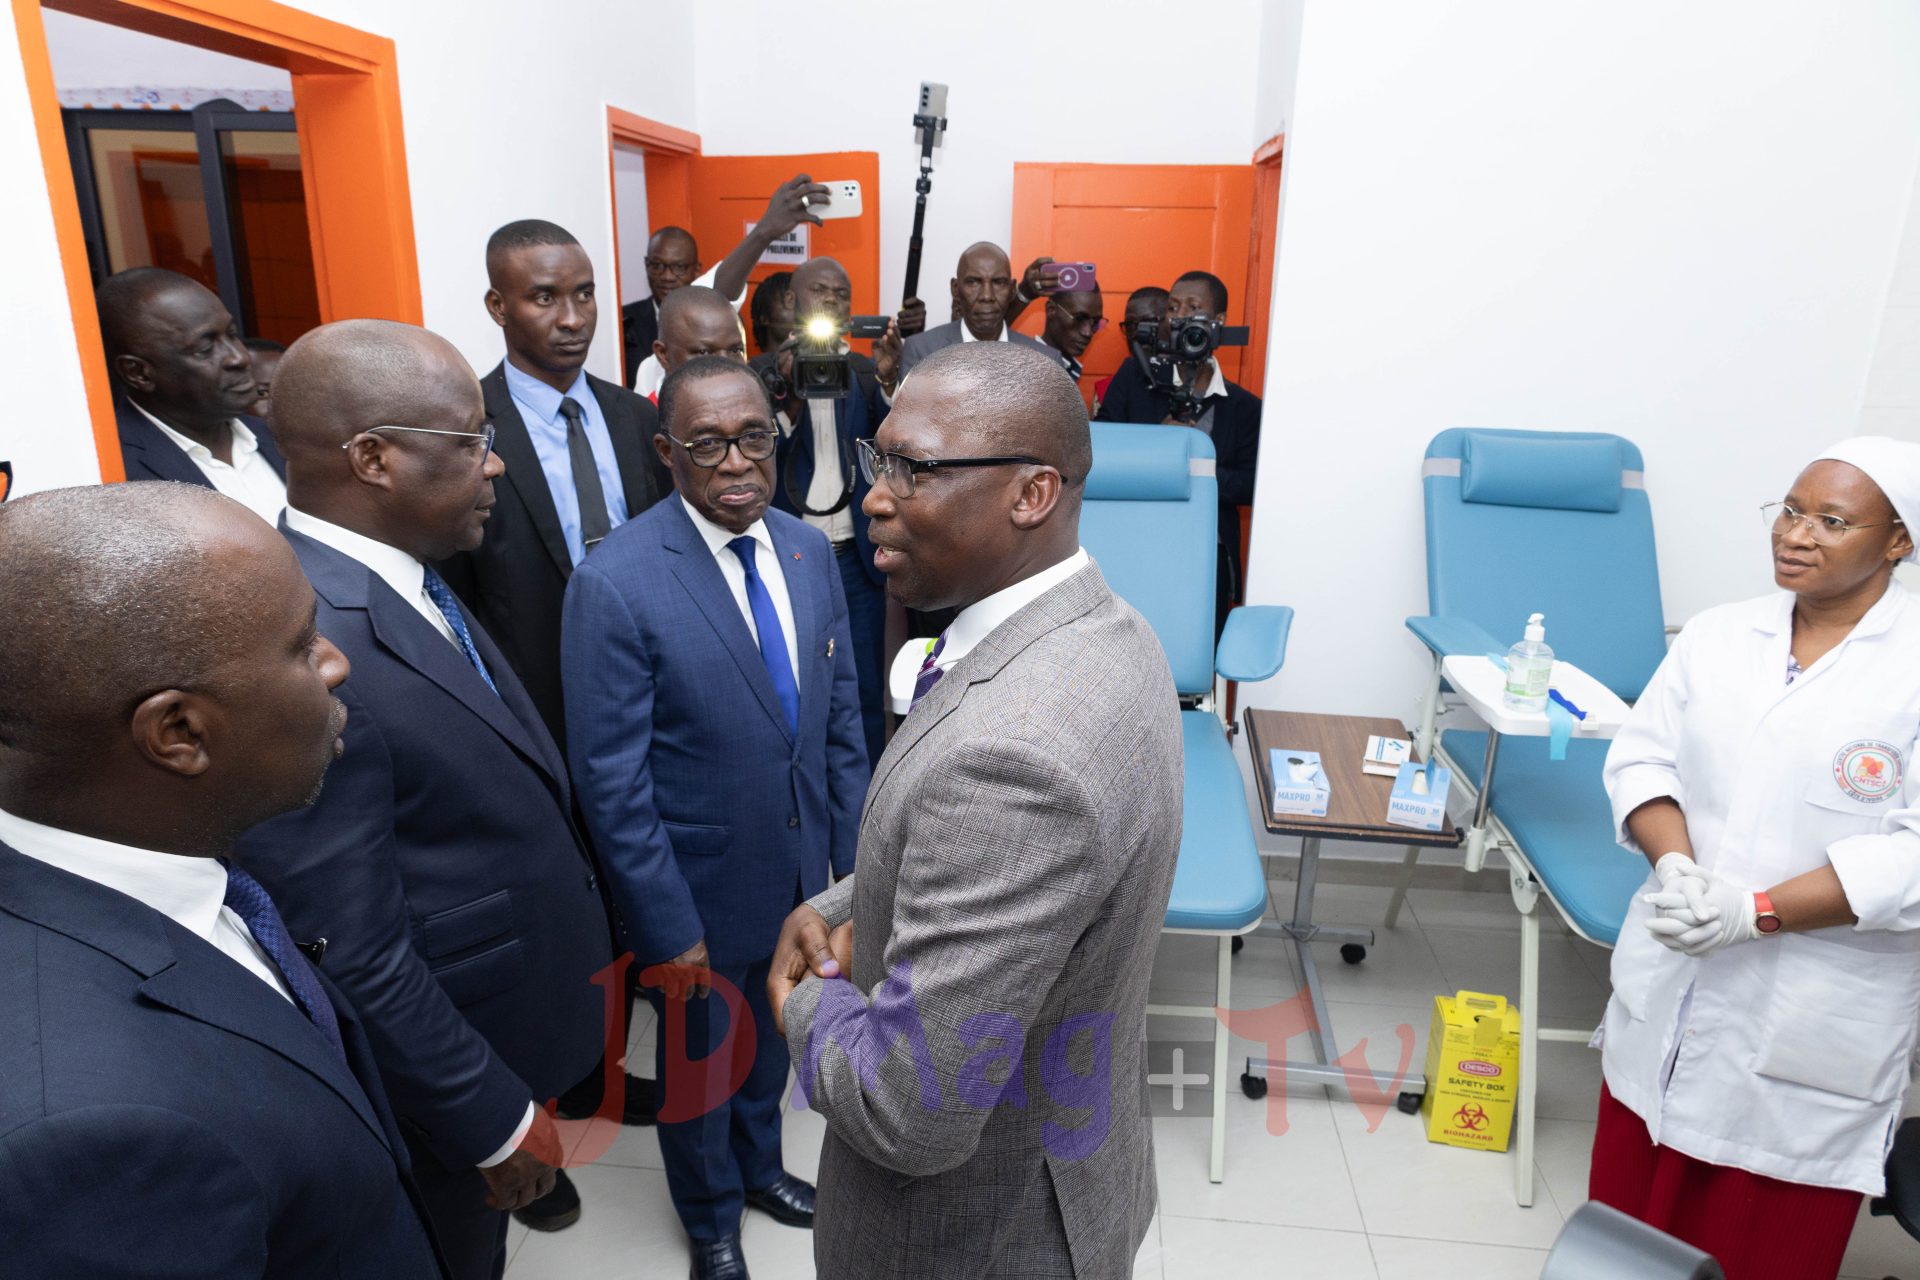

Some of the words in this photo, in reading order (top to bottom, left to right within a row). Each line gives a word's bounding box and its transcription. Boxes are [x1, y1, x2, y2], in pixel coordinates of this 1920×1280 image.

[1277, 791, 1311, 802] MAXPRO
[1391, 801, 1426, 816] MAXPRO
[1464, 1063, 1496, 1074] DESCO
[1448, 1077, 1485, 1089] SAFETY
[1486, 1082, 1505, 1092] BOX
[1443, 1129, 1494, 1142] BIOHAZARD
